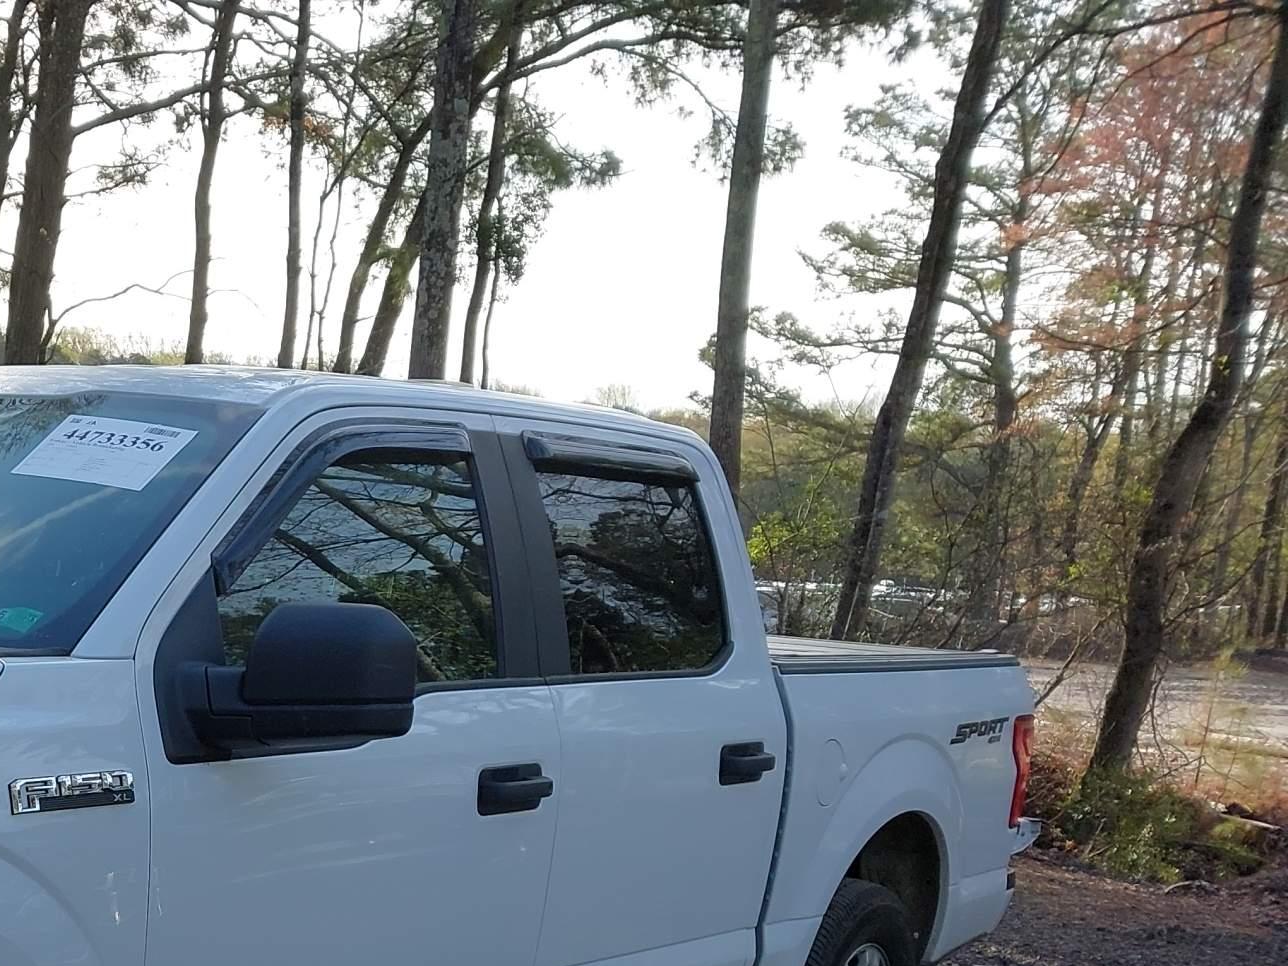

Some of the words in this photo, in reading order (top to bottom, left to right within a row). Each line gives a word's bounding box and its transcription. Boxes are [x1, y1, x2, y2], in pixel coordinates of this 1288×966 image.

[63, 429, 168, 453] 44733356
[949, 716, 1010, 745] SPORT
[112, 793, 132, 802] XL
